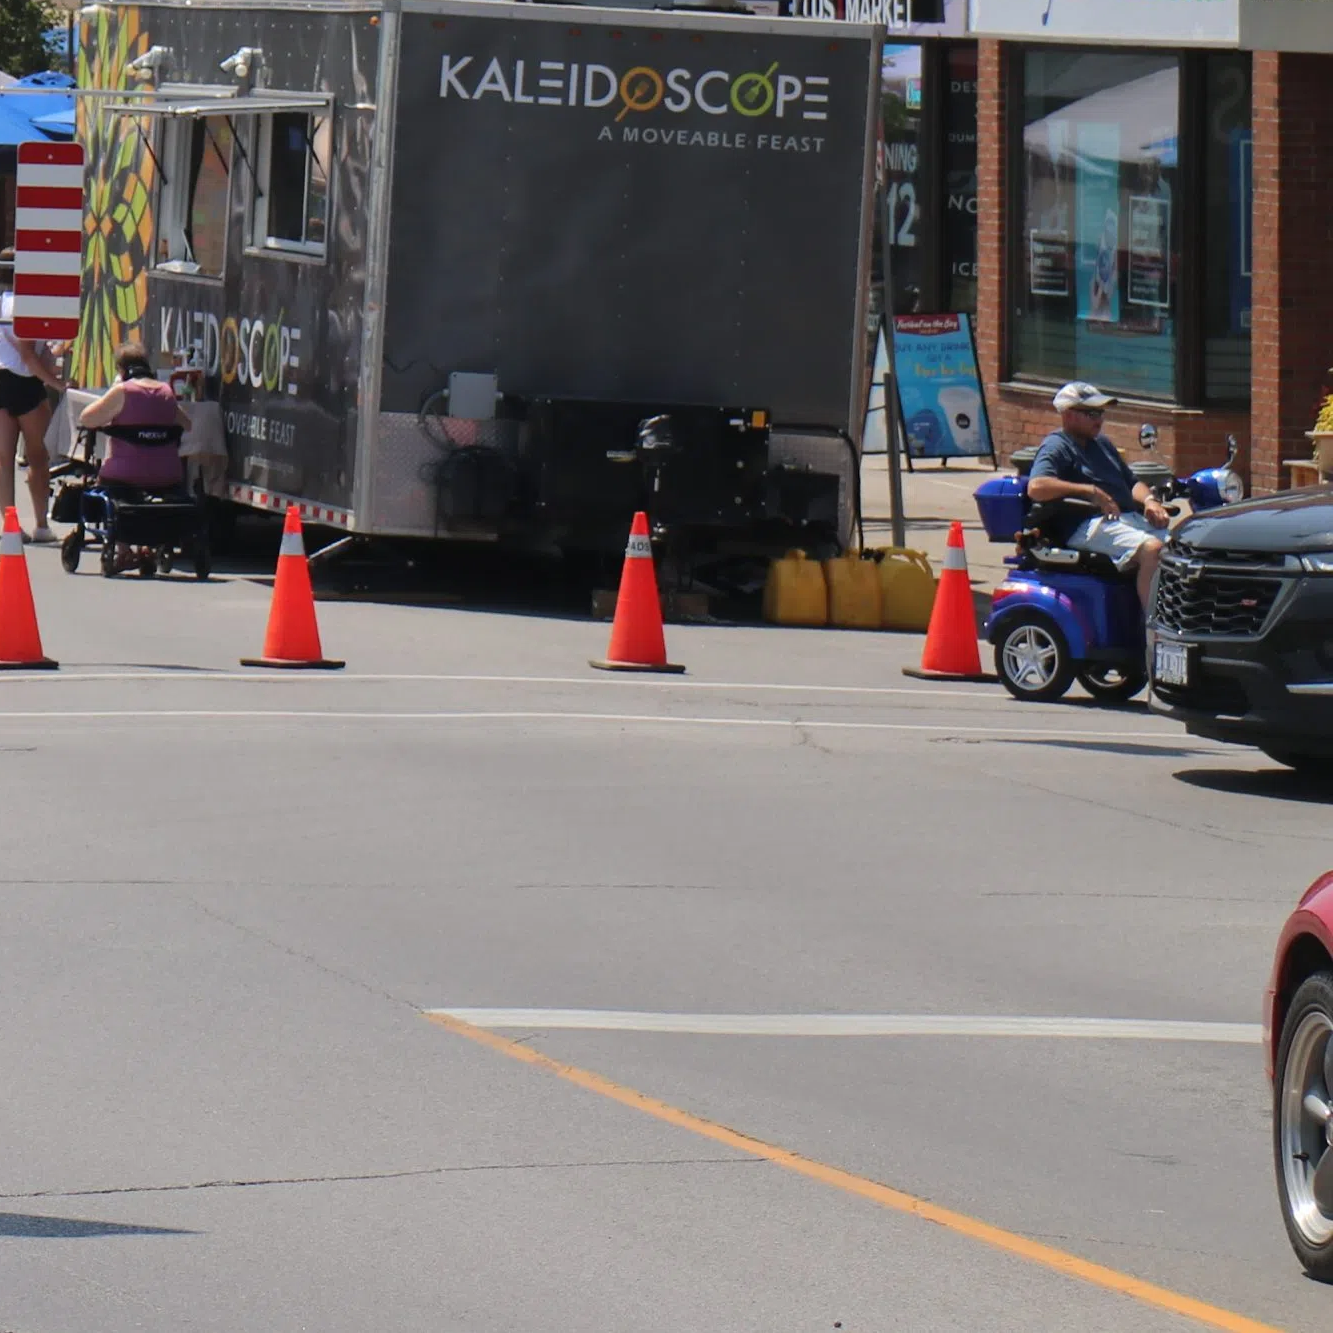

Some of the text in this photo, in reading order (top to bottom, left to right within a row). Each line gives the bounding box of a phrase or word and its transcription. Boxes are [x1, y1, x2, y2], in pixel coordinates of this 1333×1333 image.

[439, 55, 830, 120] KALEIDOSCOPE
[597, 125, 826, 154] A MOVEABLE FEAST
[886, 181, 916, 247] 12
